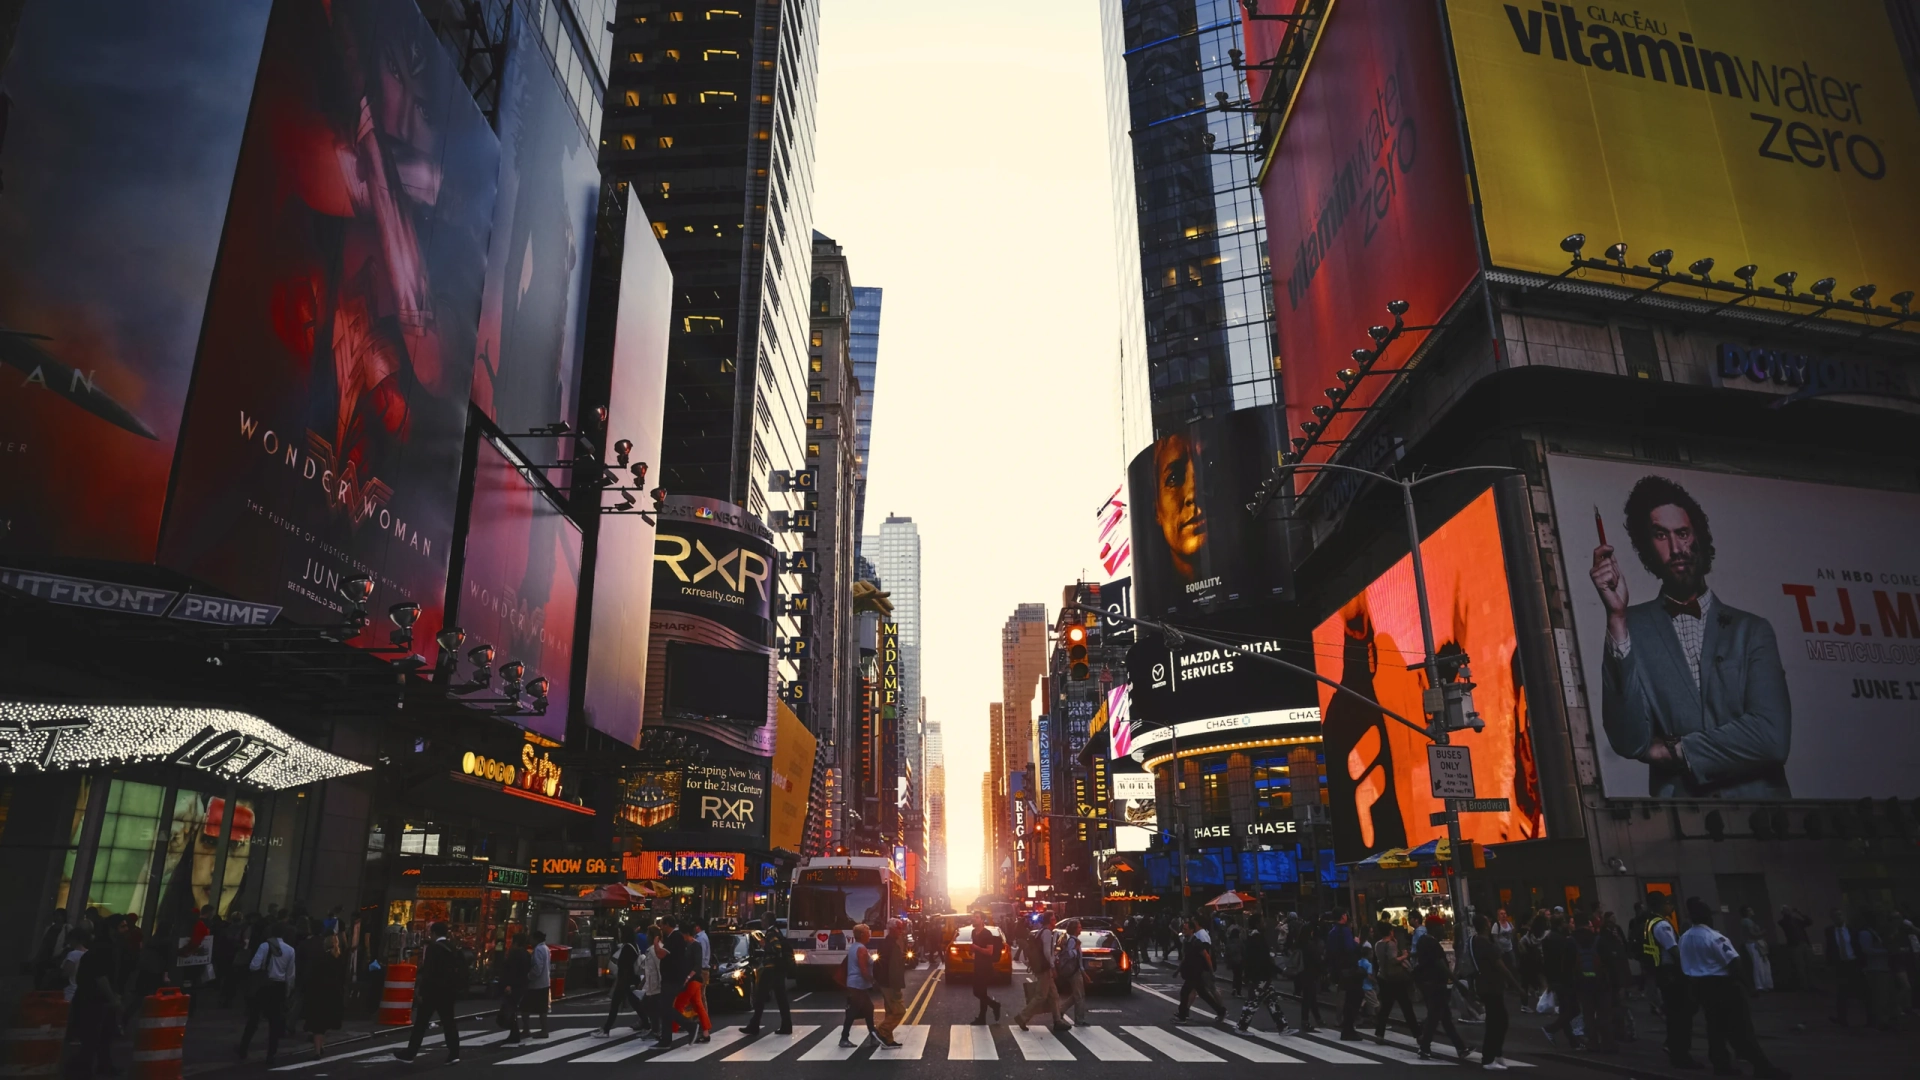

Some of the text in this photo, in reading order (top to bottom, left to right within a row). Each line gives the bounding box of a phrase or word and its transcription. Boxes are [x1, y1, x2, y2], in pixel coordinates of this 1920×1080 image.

[1750, 112, 1886, 181] zero
[1360, 117, 1417, 247] zero
[240, 410, 431, 557] WONDER WOMAN
[247, 499, 411, 598] THE FUTURE OF JUSTICE BEGINS WITH HER
[302, 558, 346, 593] JUN
[654, 533, 769, 602] RXR
[1817, 568, 1836, 580] AN
[1842, 570, 1873, 583] HBO
[794, 473, 811, 698] CHAMPS
[681, 586, 745, 606] rxrrealty.com
[185, 597, 269, 626] PRIME
[470, 580, 568, 658] WONDER WOMAN
[650, 621, 695, 632] SHARP
[884, 623, 898, 703] MADAME
[1180, 649, 1220, 667] MAZDA
[1181, 661, 1234, 681] SERVICES
[1852, 678, 1903, 700] JUNE
[1206, 717, 1239, 730] CHASE
[1436, 749, 1462, 760] BUSES
[729, 767, 747, 778] New
[748, 769, 762, 781] York
[1041, 759, 1051, 791] STUDIOS
[1440, 761, 1459, 770] ONLY
[686, 778, 763, 798] for the 21st Century
[1095, 757, 1106, 802] VICTORY
[701, 796, 754, 823] RXR
[1469, 800, 1507, 810] Broadway
[712, 820, 746, 830] REALTY
[1015, 800, 1025, 862] REGAL
[1079, 823, 1087, 841] NEW
[1194, 821, 1297, 839] CHASE CHASE
[542, 858, 582, 874] KNOW
[658, 856, 736, 875] CHAMPS
[1415, 880, 1440, 893] SODA
